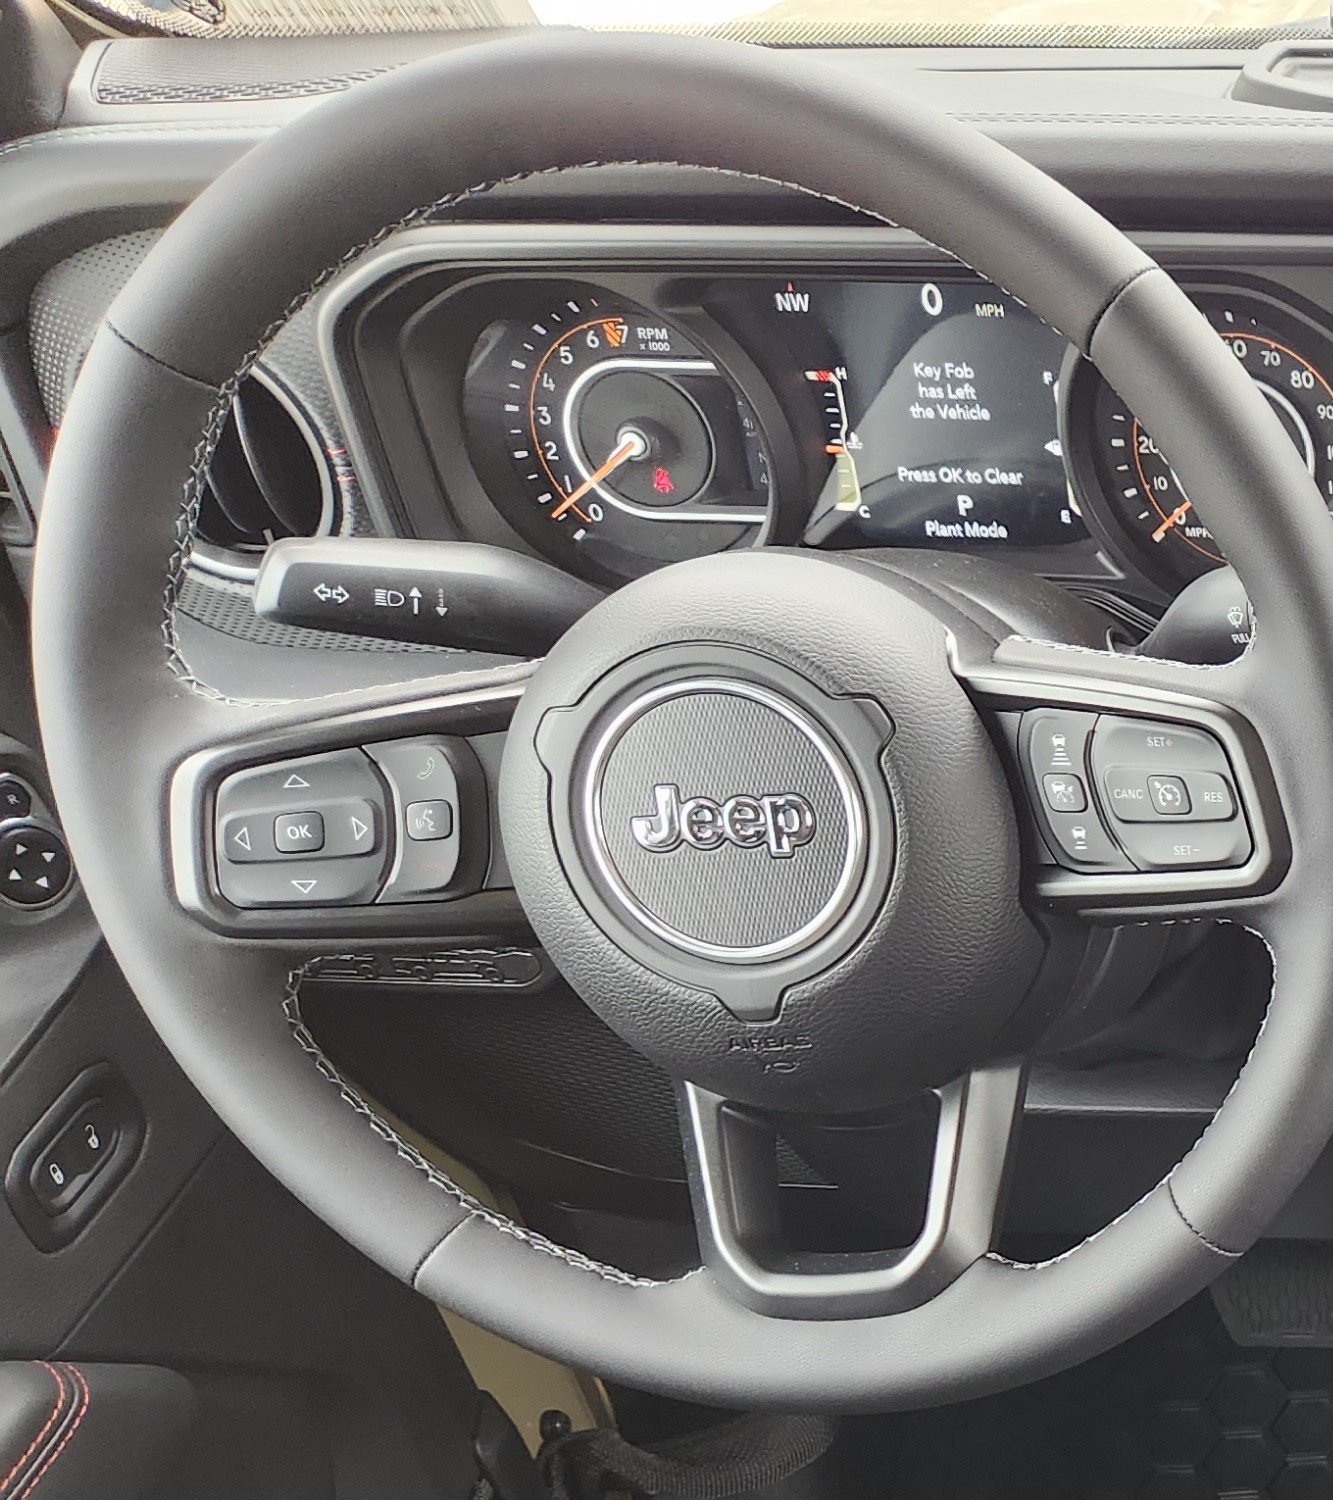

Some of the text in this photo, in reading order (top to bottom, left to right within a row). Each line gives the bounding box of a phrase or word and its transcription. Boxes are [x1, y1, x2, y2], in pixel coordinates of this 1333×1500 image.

[775, 293, 809, 312] NW
[921, 283, 943, 316] 0
[975, 304, 1004, 318] MPH
[586, 331, 599, 348] 6
[619, 325, 629, 343] 7
[637, 327, 668, 340] RPM
[559, 346, 573, 365] 5
[648, 342, 670, 351] 1000
[1259, 351, 1281, 366] 70
[836, 367, 847, 381] H
[913, 362, 974, 381] Key Fob
[1291, 370, 1314, 389] 80
[542, 373, 555, 391] 4
[919, 383, 977, 400] has Left
[537, 406, 551, 425] 3
[910, 403, 991, 421] the Vehicle
[546, 441, 559, 461] 2
[898, 467, 1024, 485] Press OK to Clear
[1153, 476, 1168, 491] 10
[589, 503, 603, 522] 0
[957, 495, 974, 516] P
[926, 521, 1008, 539] Plant Mode
[1114, 788, 1143, 800] CANC
[1204, 791, 1223, 803] RES
[631, 784, 817, 858] Jeep
[287, 824, 312, 839] OK
